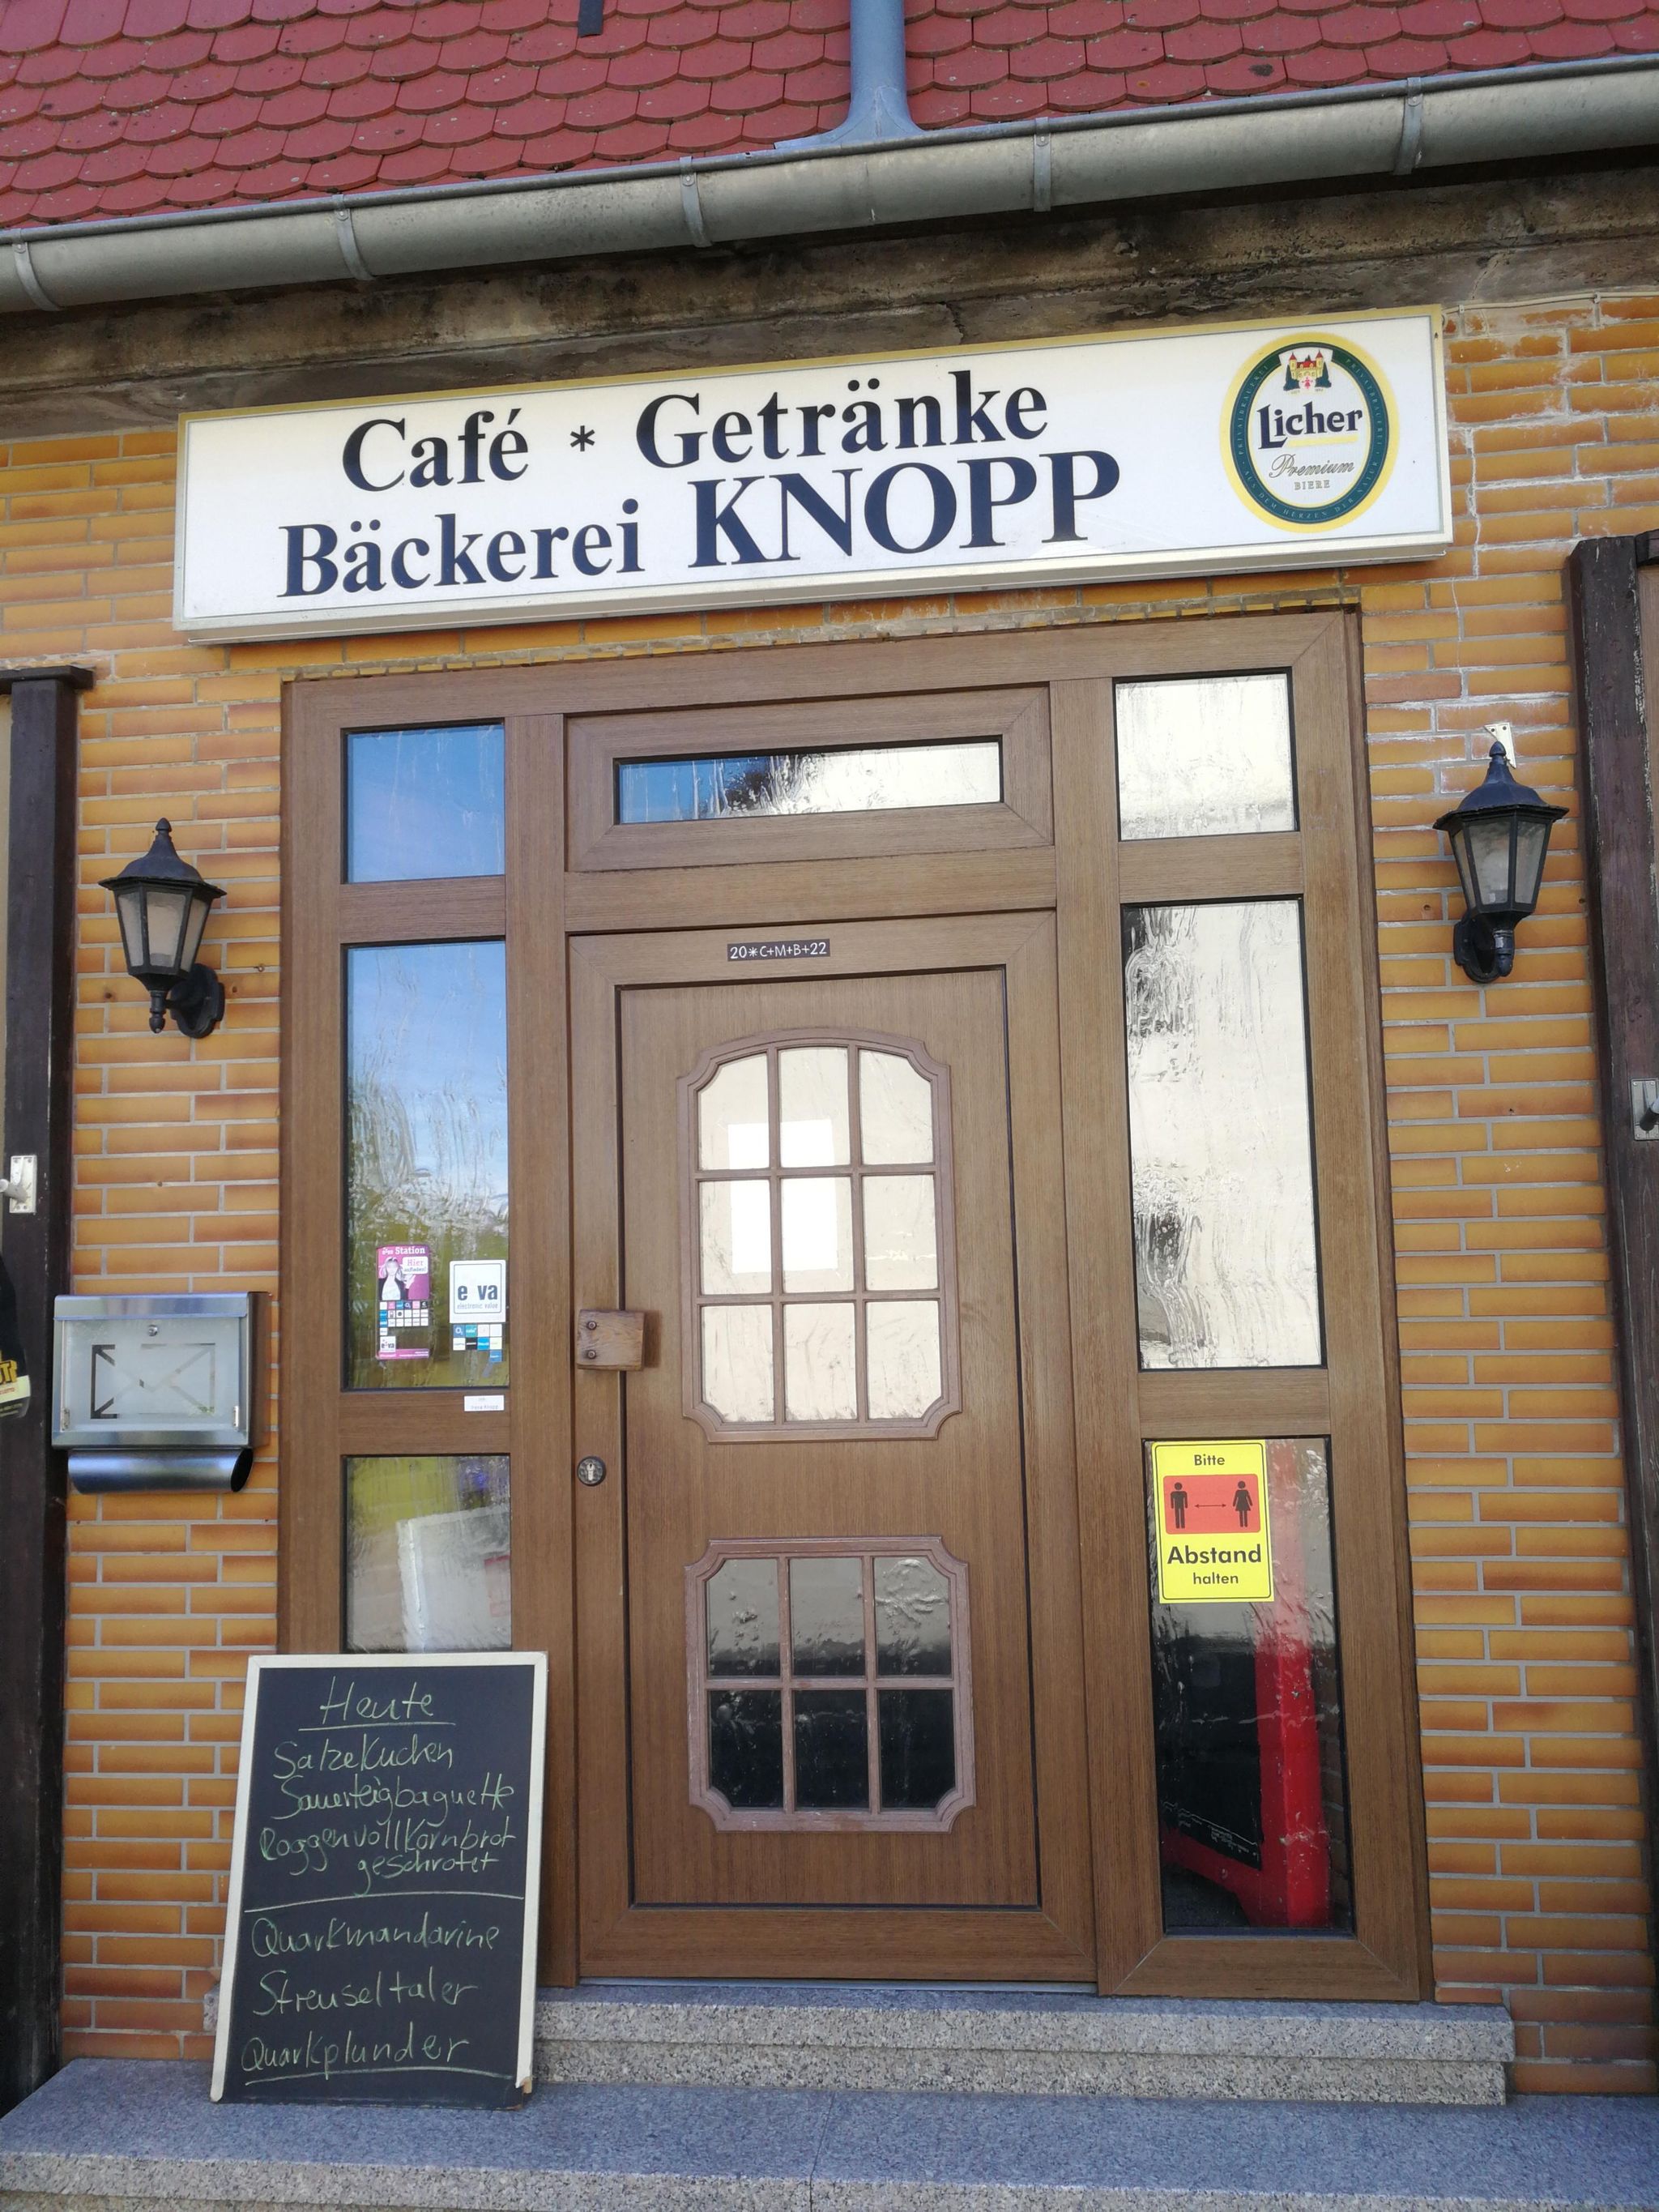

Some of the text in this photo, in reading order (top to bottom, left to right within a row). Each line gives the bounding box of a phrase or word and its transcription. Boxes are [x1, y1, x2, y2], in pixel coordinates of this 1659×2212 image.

[343, 370, 1048, 492] Café Getränke
[1256, 401, 1363, 450] Licher
[1269, 454, 1355, 479] Premium
[1294, 480, 1331, 491] BIERE
[277, 451, 1120, 598] Bäckerei KNOPP
[394, 1246, 426, 1255] Station
[1193, 1454, 1226, 1467] Bitte
[1166, 1544, 1261, 1565] Abstand
[1192, 1571, 1239, 1585] halten
[320, 1676, 434, 1724] Heute
[253, 1966, 480, 2016] Streuseltaler
